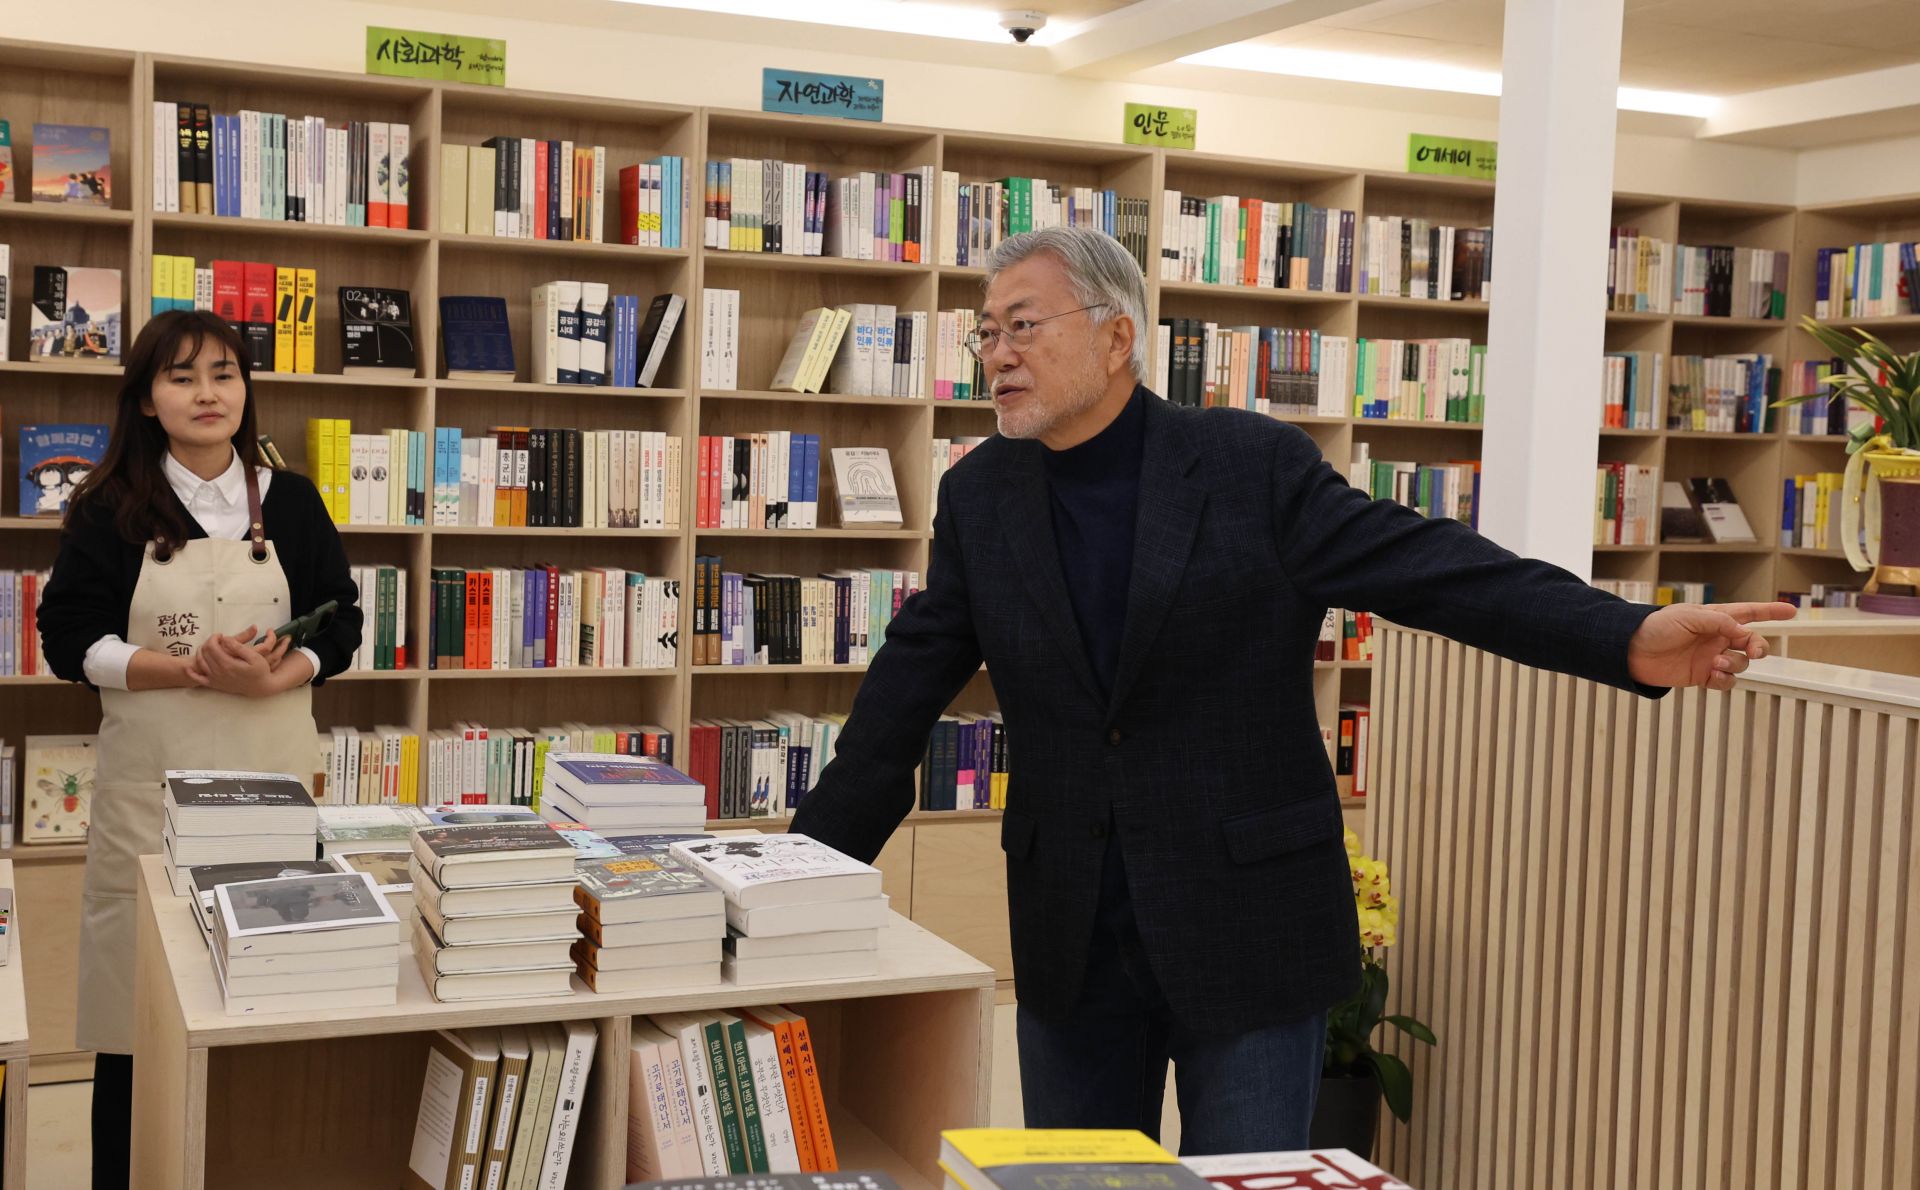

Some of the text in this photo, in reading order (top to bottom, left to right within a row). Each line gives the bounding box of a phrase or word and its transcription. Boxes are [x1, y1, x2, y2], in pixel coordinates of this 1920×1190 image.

[377, 36, 464, 70] 사회과학
[776, 80, 855, 108] 자연과학
[1134, 110, 1170, 136] 인문
[1416, 145, 1471, 166] 에세이
[346, 290, 361, 301] 02
[560, 316, 578, 326] 공감의
[560, 327, 573, 335] 시대
[585, 328, 599, 336] 시대
[586, 317, 606, 327] 공감의
[856, 326, 873, 336] 바다
[877, 326, 894, 336] 바다
[856, 336, 872, 346] 인류
[877, 336, 893, 347] 인류
[468, 578, 477, 605] 카스트
[482, 578, 491, 605] 카스트
[781, 1033, 796, 1079] 선배시민
[798, 1030, 814, 1076] 선배시민
[711, 1040, 720, 1055] 한나
[720, 1087, 730, 1102] 번의
[734, 1041, 743, 1056] 한나
[742, 1088, 753, 1103] 번의
[767, 1055, 778, 1081] 공부란
[773, 1082, 785, 1114] 무엇인가
[653, 1064, 672, 1129] 고기로 태어나서
[671, 1059, 691, 1125] 고기로 태어나서
[754, 1060, 766, 1084] 공부란
[761, 1085, 772, 1117] 무엇인가
